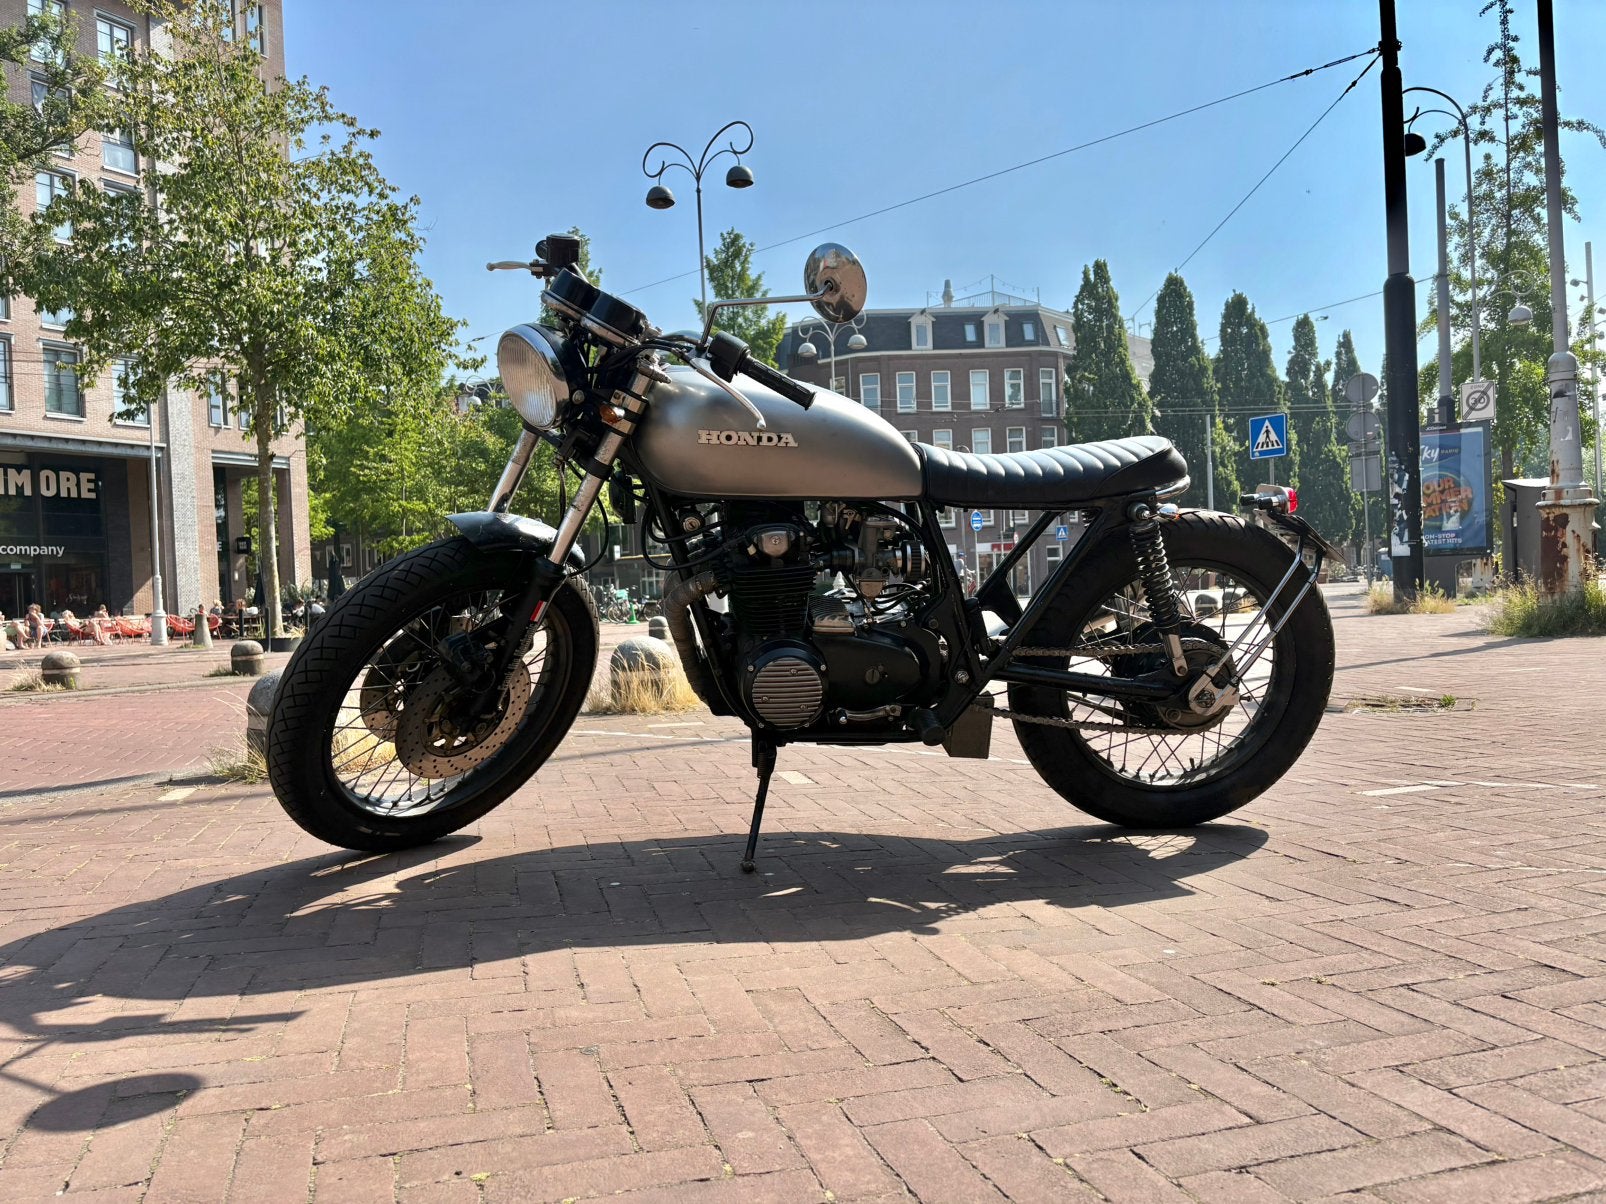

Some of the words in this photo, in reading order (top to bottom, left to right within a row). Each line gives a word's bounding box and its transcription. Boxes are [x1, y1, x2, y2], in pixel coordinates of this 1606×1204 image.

[1471, 396, 1486, 405] 30
[697, 429, 799, 447] HONDA
[1420, 445, 1440, 462] ky
[1423, 476, 1455, 495] OUR
[0, 545, 65, 558] company
